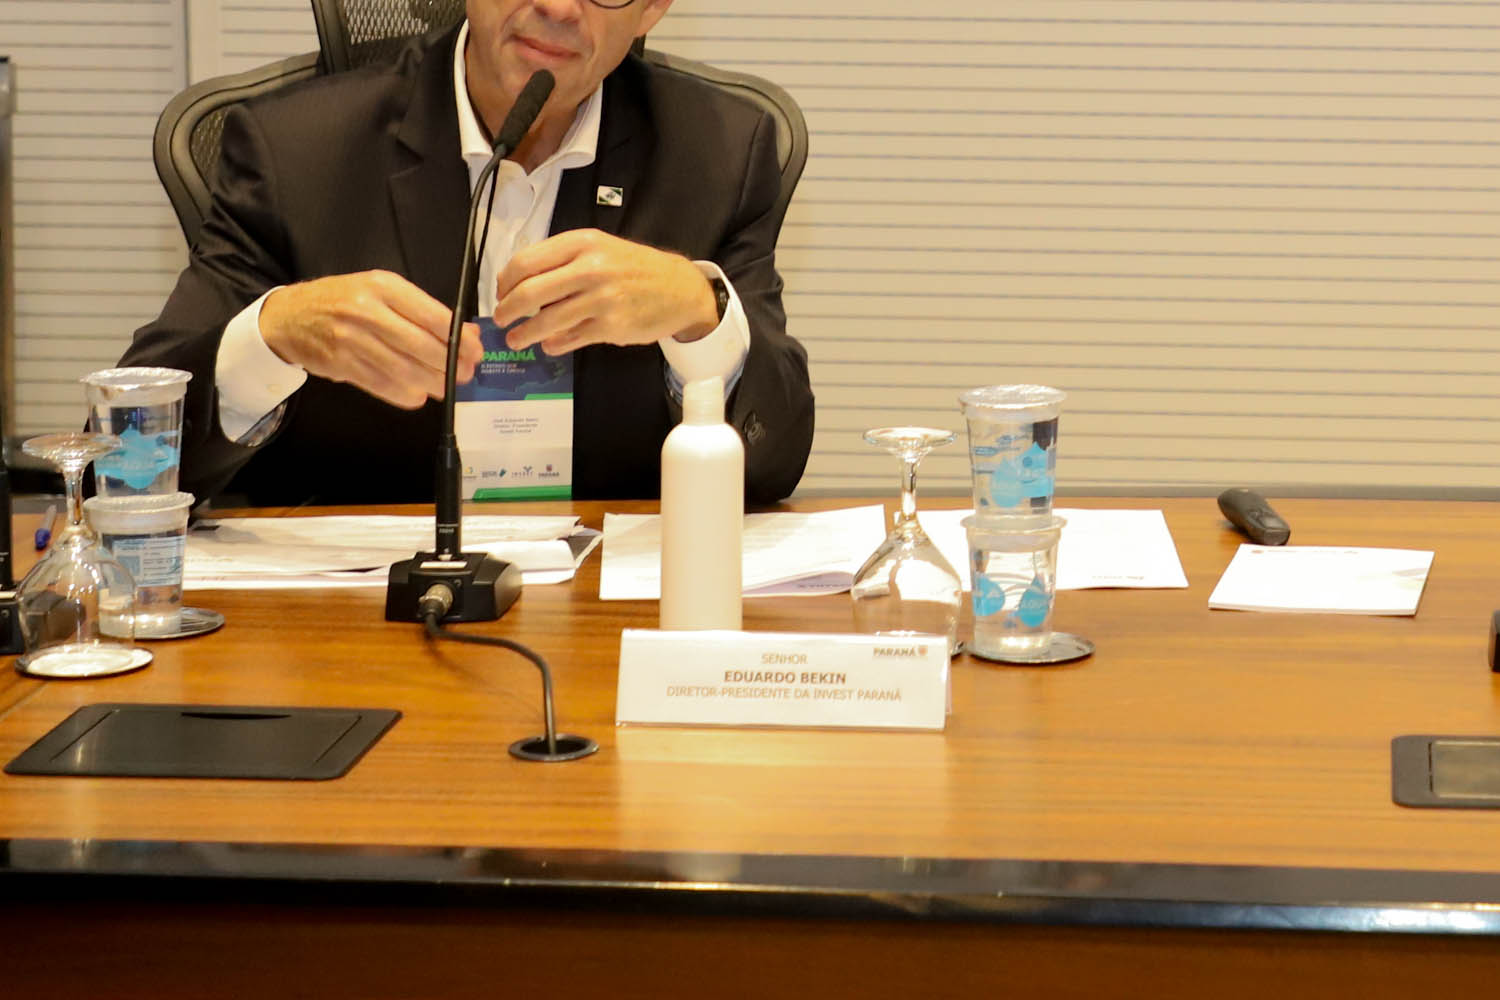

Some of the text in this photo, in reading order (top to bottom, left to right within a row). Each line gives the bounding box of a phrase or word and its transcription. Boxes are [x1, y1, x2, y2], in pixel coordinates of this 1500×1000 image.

[482, 349, 535, 361] PARANÁ
[873, 646, 916, 658] PARANÁ
[761, 653, 807, 665] SENHOR
[724, 670, 847, 685] EDUARDO BEKIN
[666, 686, 902, 701] DIRETOR-PRESIDENTE DA INVEST PARANÁ
